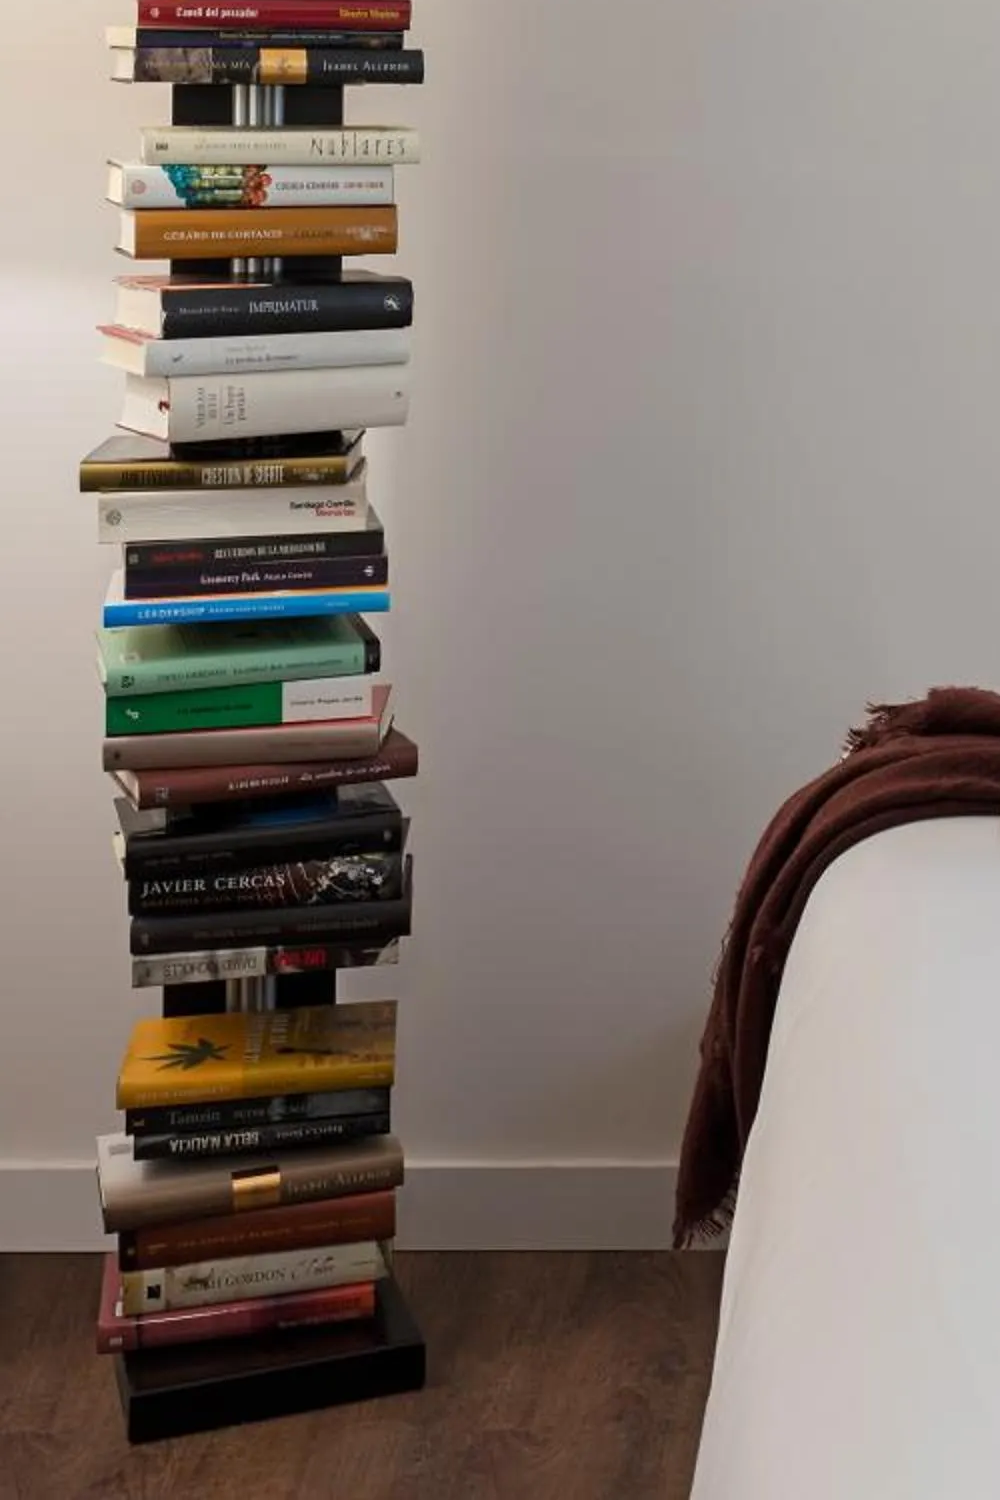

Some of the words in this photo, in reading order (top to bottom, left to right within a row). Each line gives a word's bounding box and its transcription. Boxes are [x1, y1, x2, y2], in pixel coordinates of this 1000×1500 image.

[249, 299, 320, 314] IMPRIMATUR
[140, 878, 207, 899] JAVIER
[213, 872, 286, 891] CERCAS
[224, 1268, 286, 1286] GORDON
